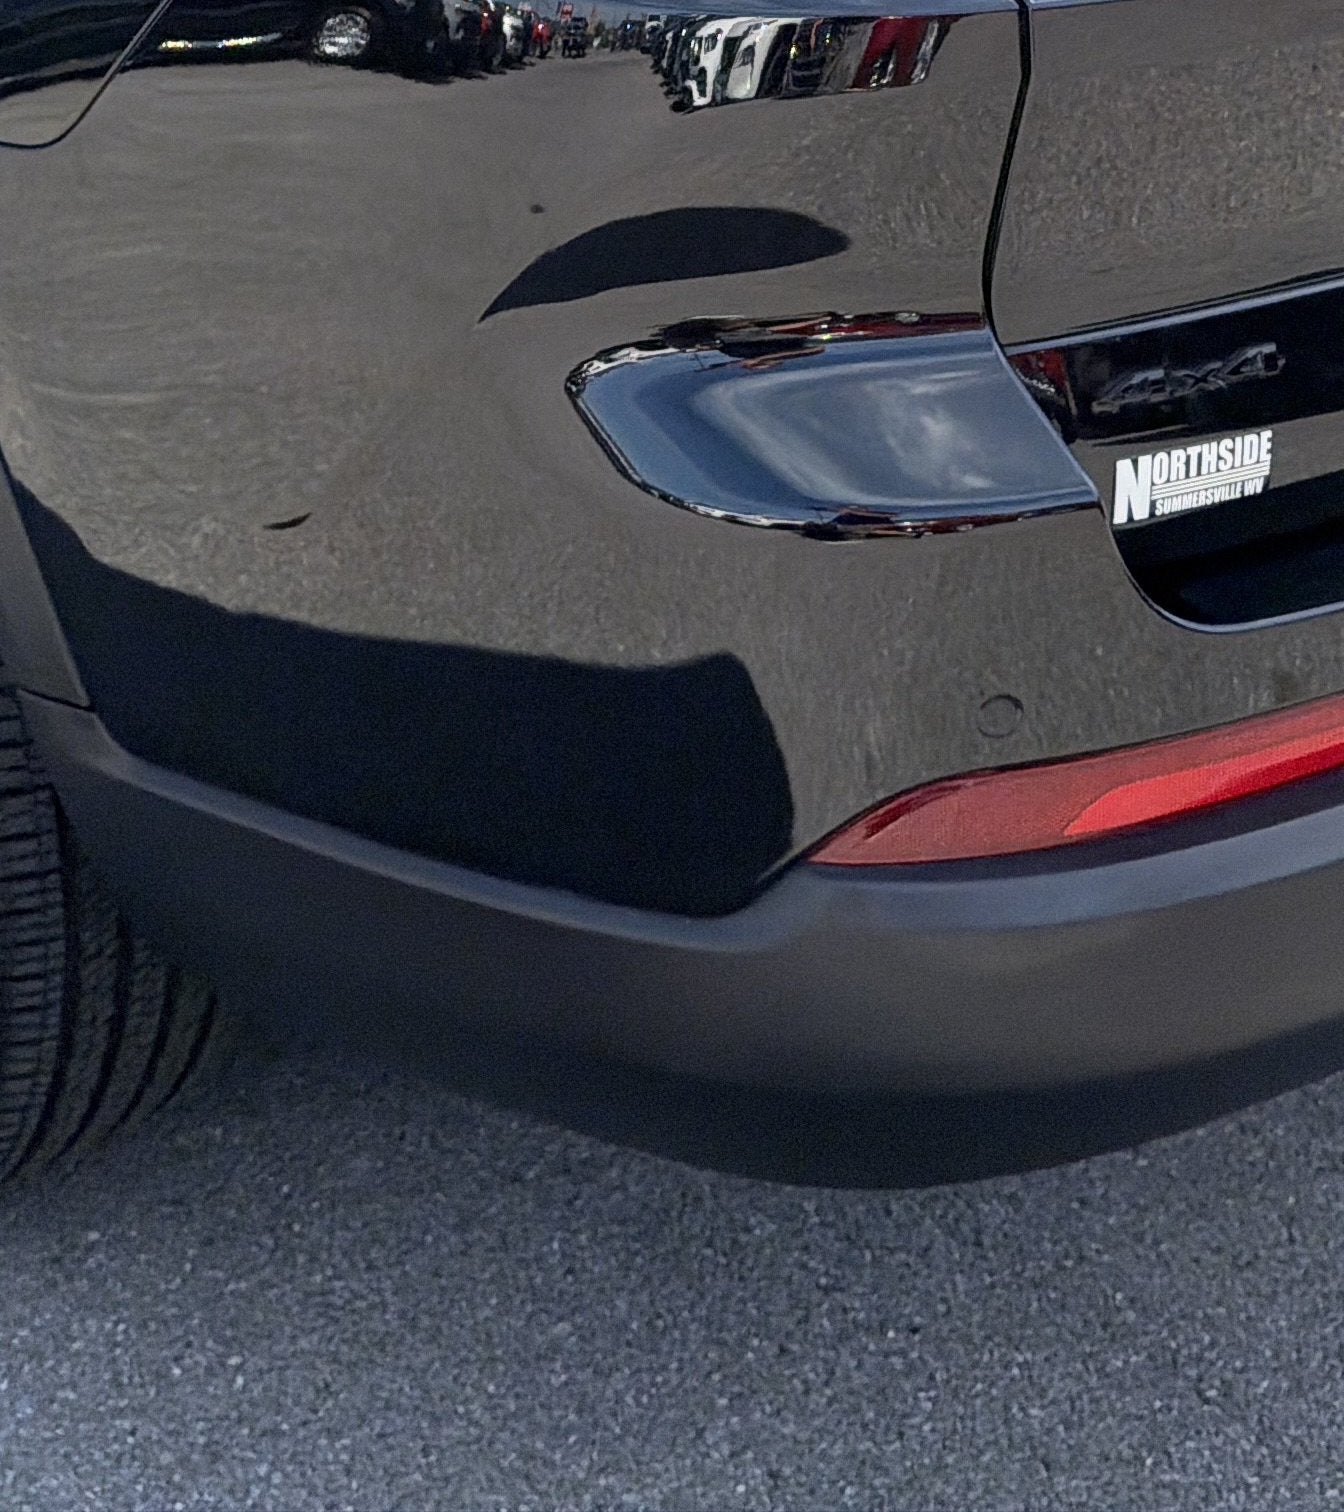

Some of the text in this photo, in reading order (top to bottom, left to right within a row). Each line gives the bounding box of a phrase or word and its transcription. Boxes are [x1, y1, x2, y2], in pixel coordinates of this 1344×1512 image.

[1112, 429, 1273, 525] NORTHSIDE
[1155, 477, 1265, 517] SUMMERSVILLE WV
